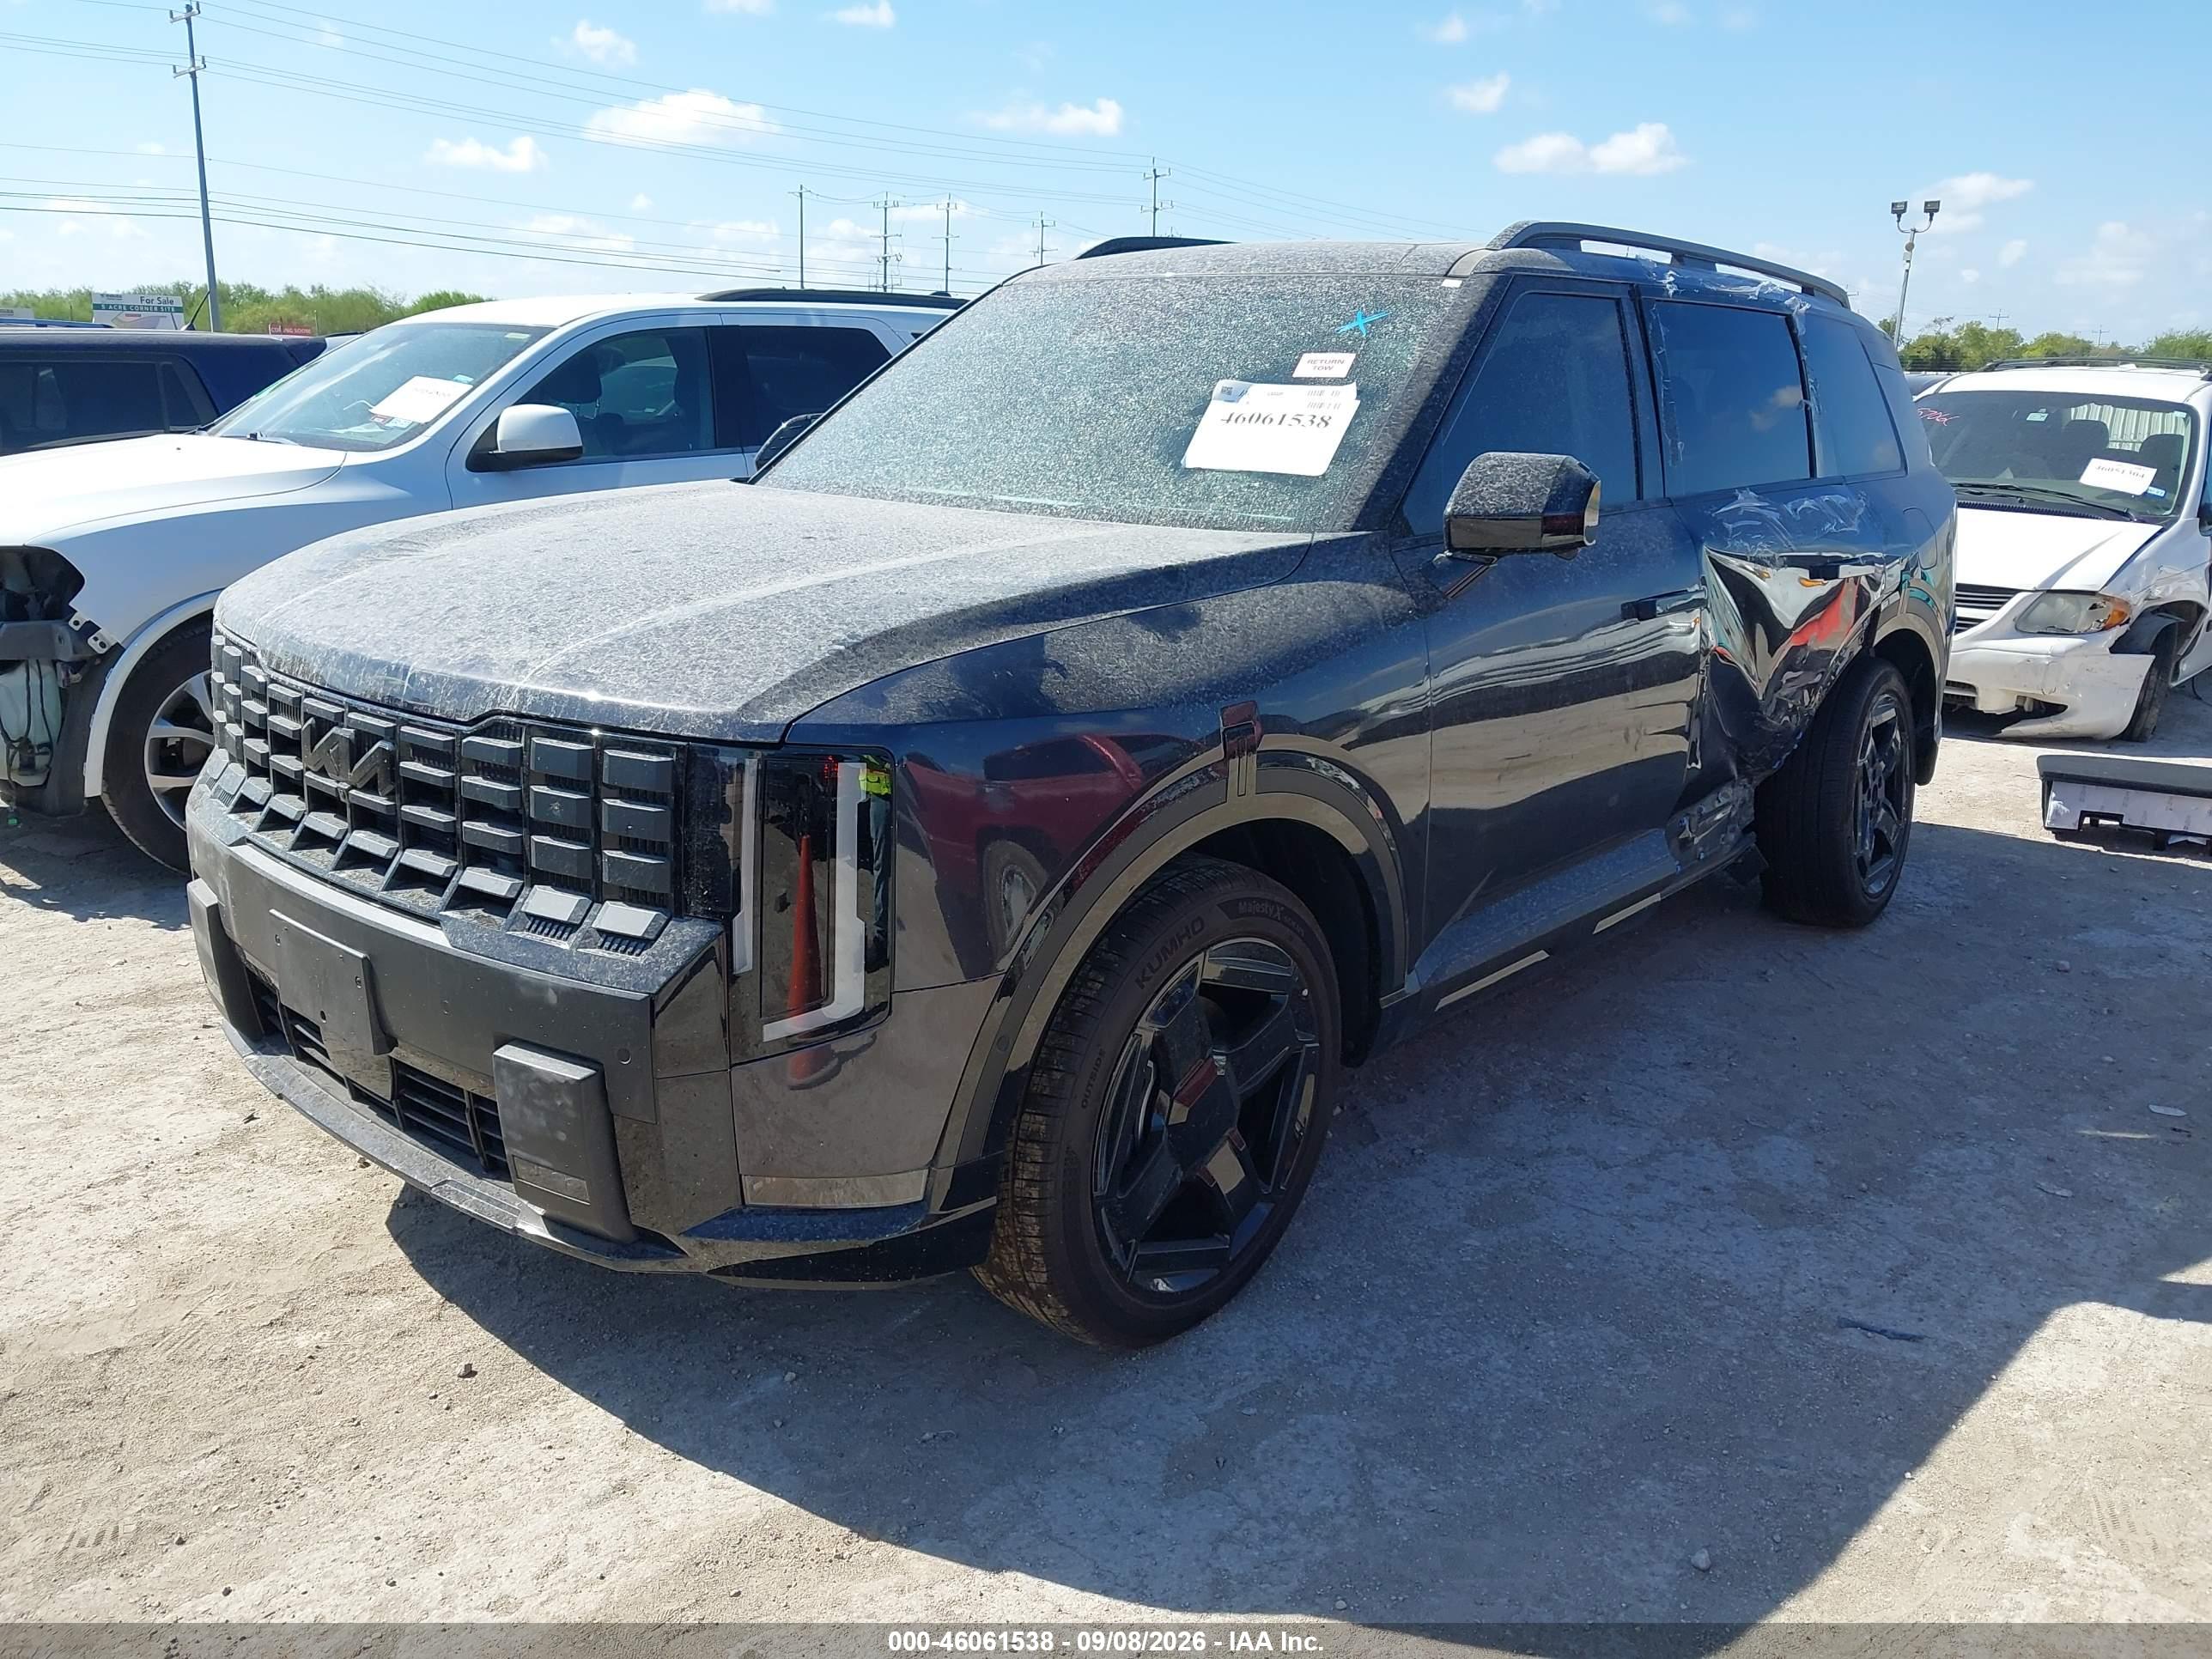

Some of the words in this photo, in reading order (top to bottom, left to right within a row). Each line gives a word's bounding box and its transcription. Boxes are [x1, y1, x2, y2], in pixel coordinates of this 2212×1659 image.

[140, 295, 155, 305] For
[157, 296, 174, 306] Sale
[1220, 411, 1332, 429] 46061538
[1134, 915, 1206, 990] KUMHO
[1080, 1047, 1107, 1109] OUTSIDE
